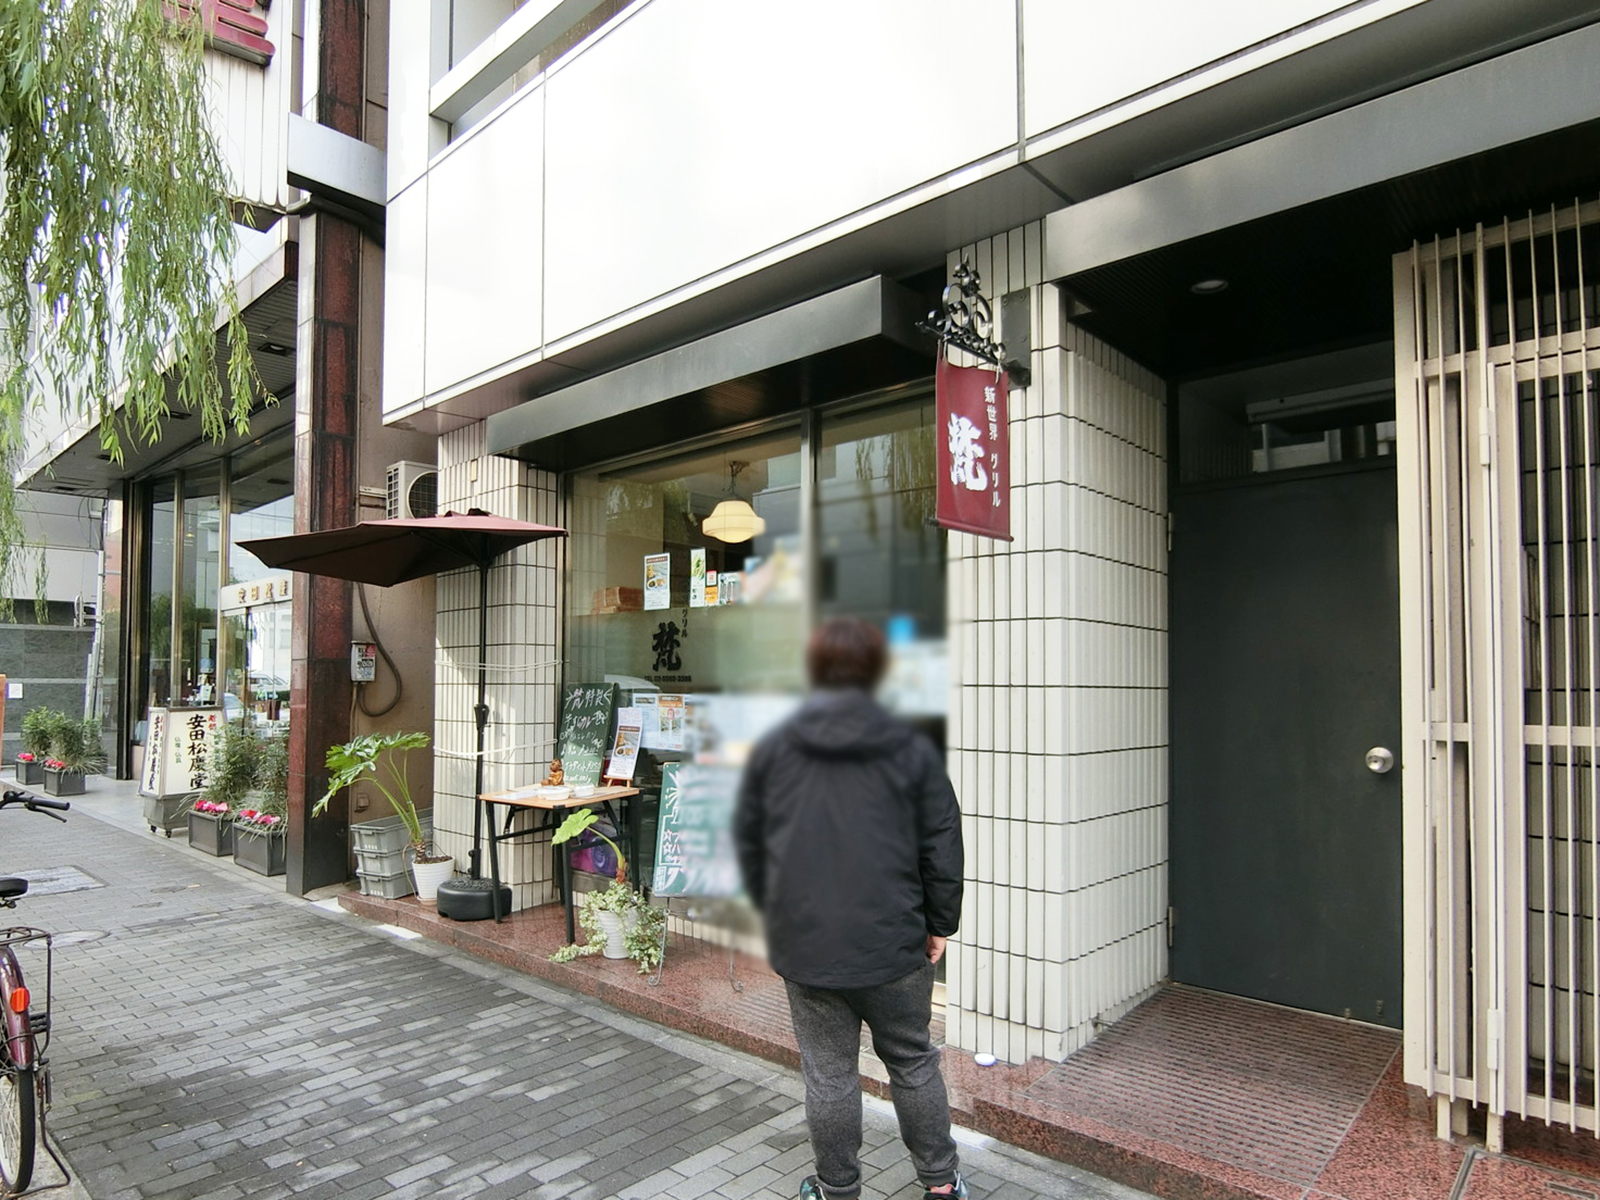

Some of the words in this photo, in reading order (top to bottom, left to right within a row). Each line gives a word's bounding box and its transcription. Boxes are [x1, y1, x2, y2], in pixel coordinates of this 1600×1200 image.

[984, 386, 998, 440] 新世界
[991, 453, 1001, 507] グリル
[187, 714, 208, 790] 安田松慶堂
